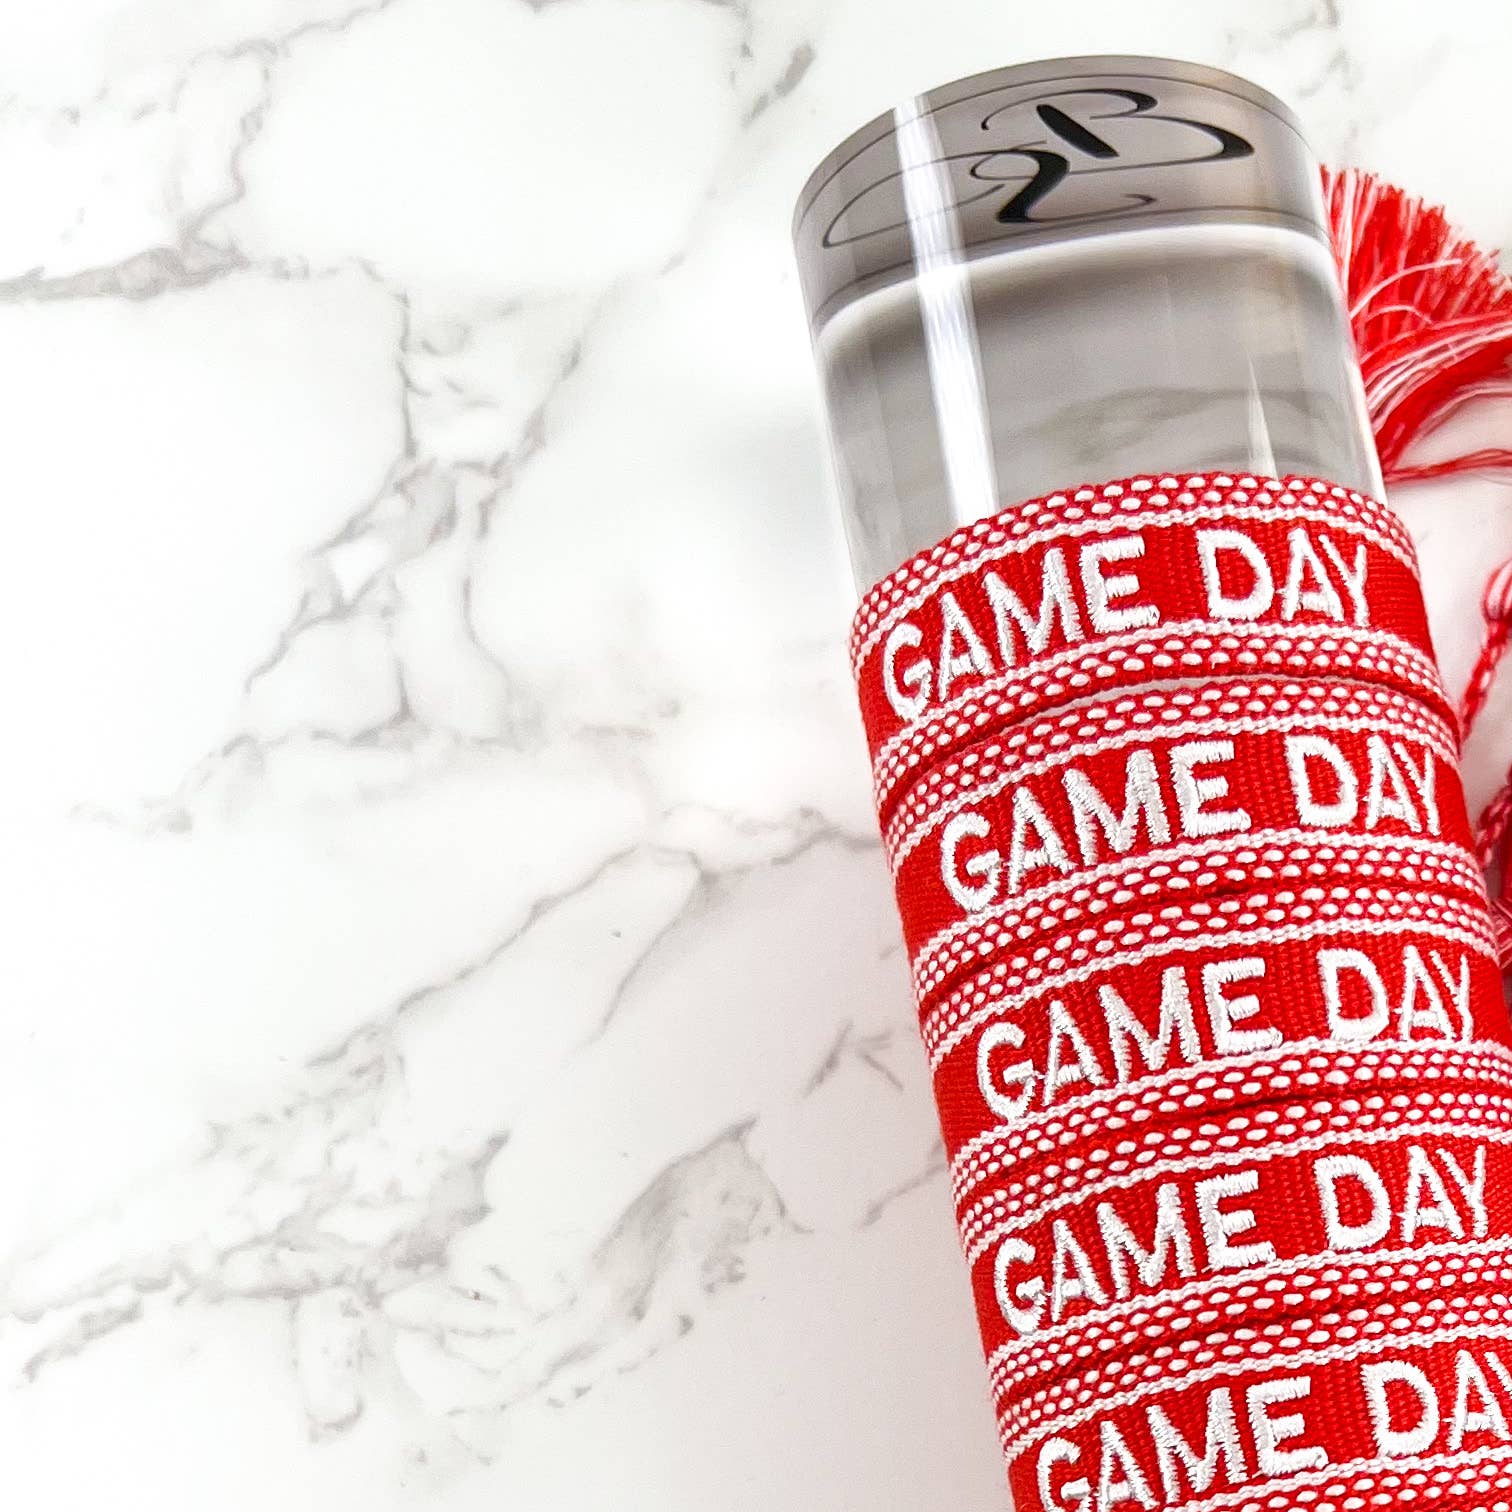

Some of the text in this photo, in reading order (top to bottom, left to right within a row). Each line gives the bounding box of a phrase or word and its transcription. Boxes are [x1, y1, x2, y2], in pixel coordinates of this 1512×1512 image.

[882, 528, 1369, 721] GAME DAY
[940, 733, 1443, 913] GAME DAY
[977, 944, 1473, 1121] GAME DAY
[994, 1145, 1488, 1335] GAME DAY
